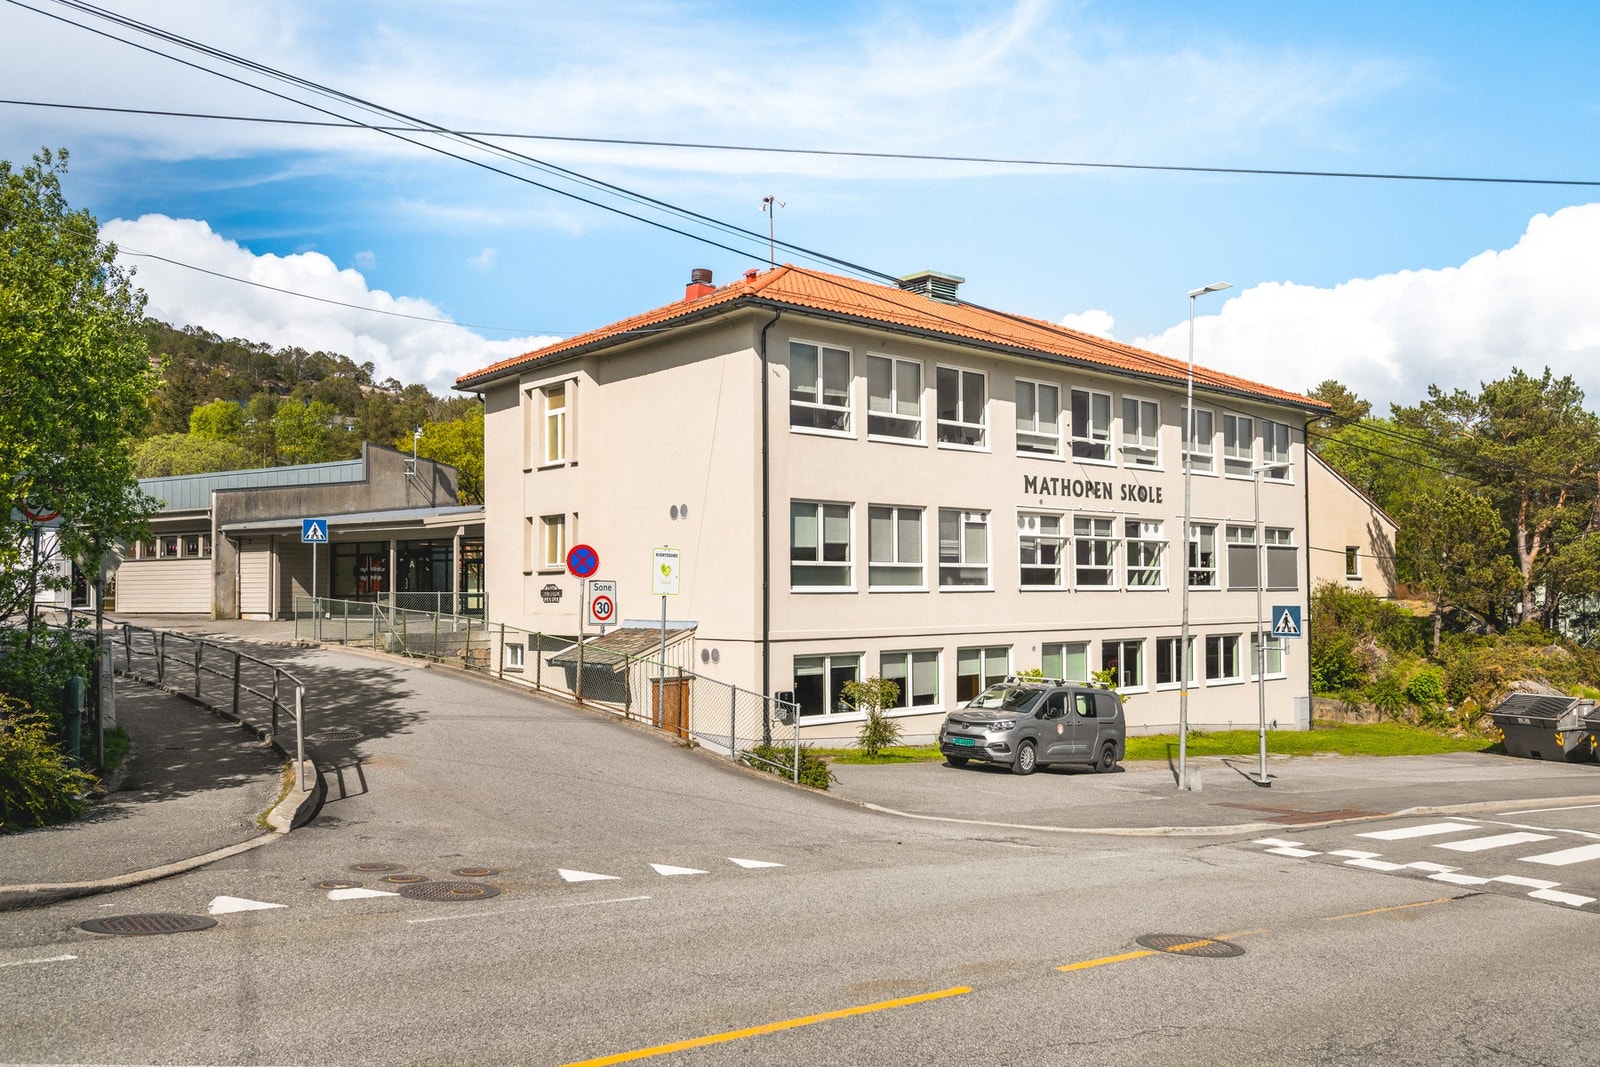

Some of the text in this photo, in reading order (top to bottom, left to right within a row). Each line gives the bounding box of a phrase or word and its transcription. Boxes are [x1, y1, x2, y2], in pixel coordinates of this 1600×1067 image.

[1024, 475, 1163, 503] MATHOPEN SKOLE
[594, 583, 612, 591] Sone
[596, 602, 610, 614] 30
